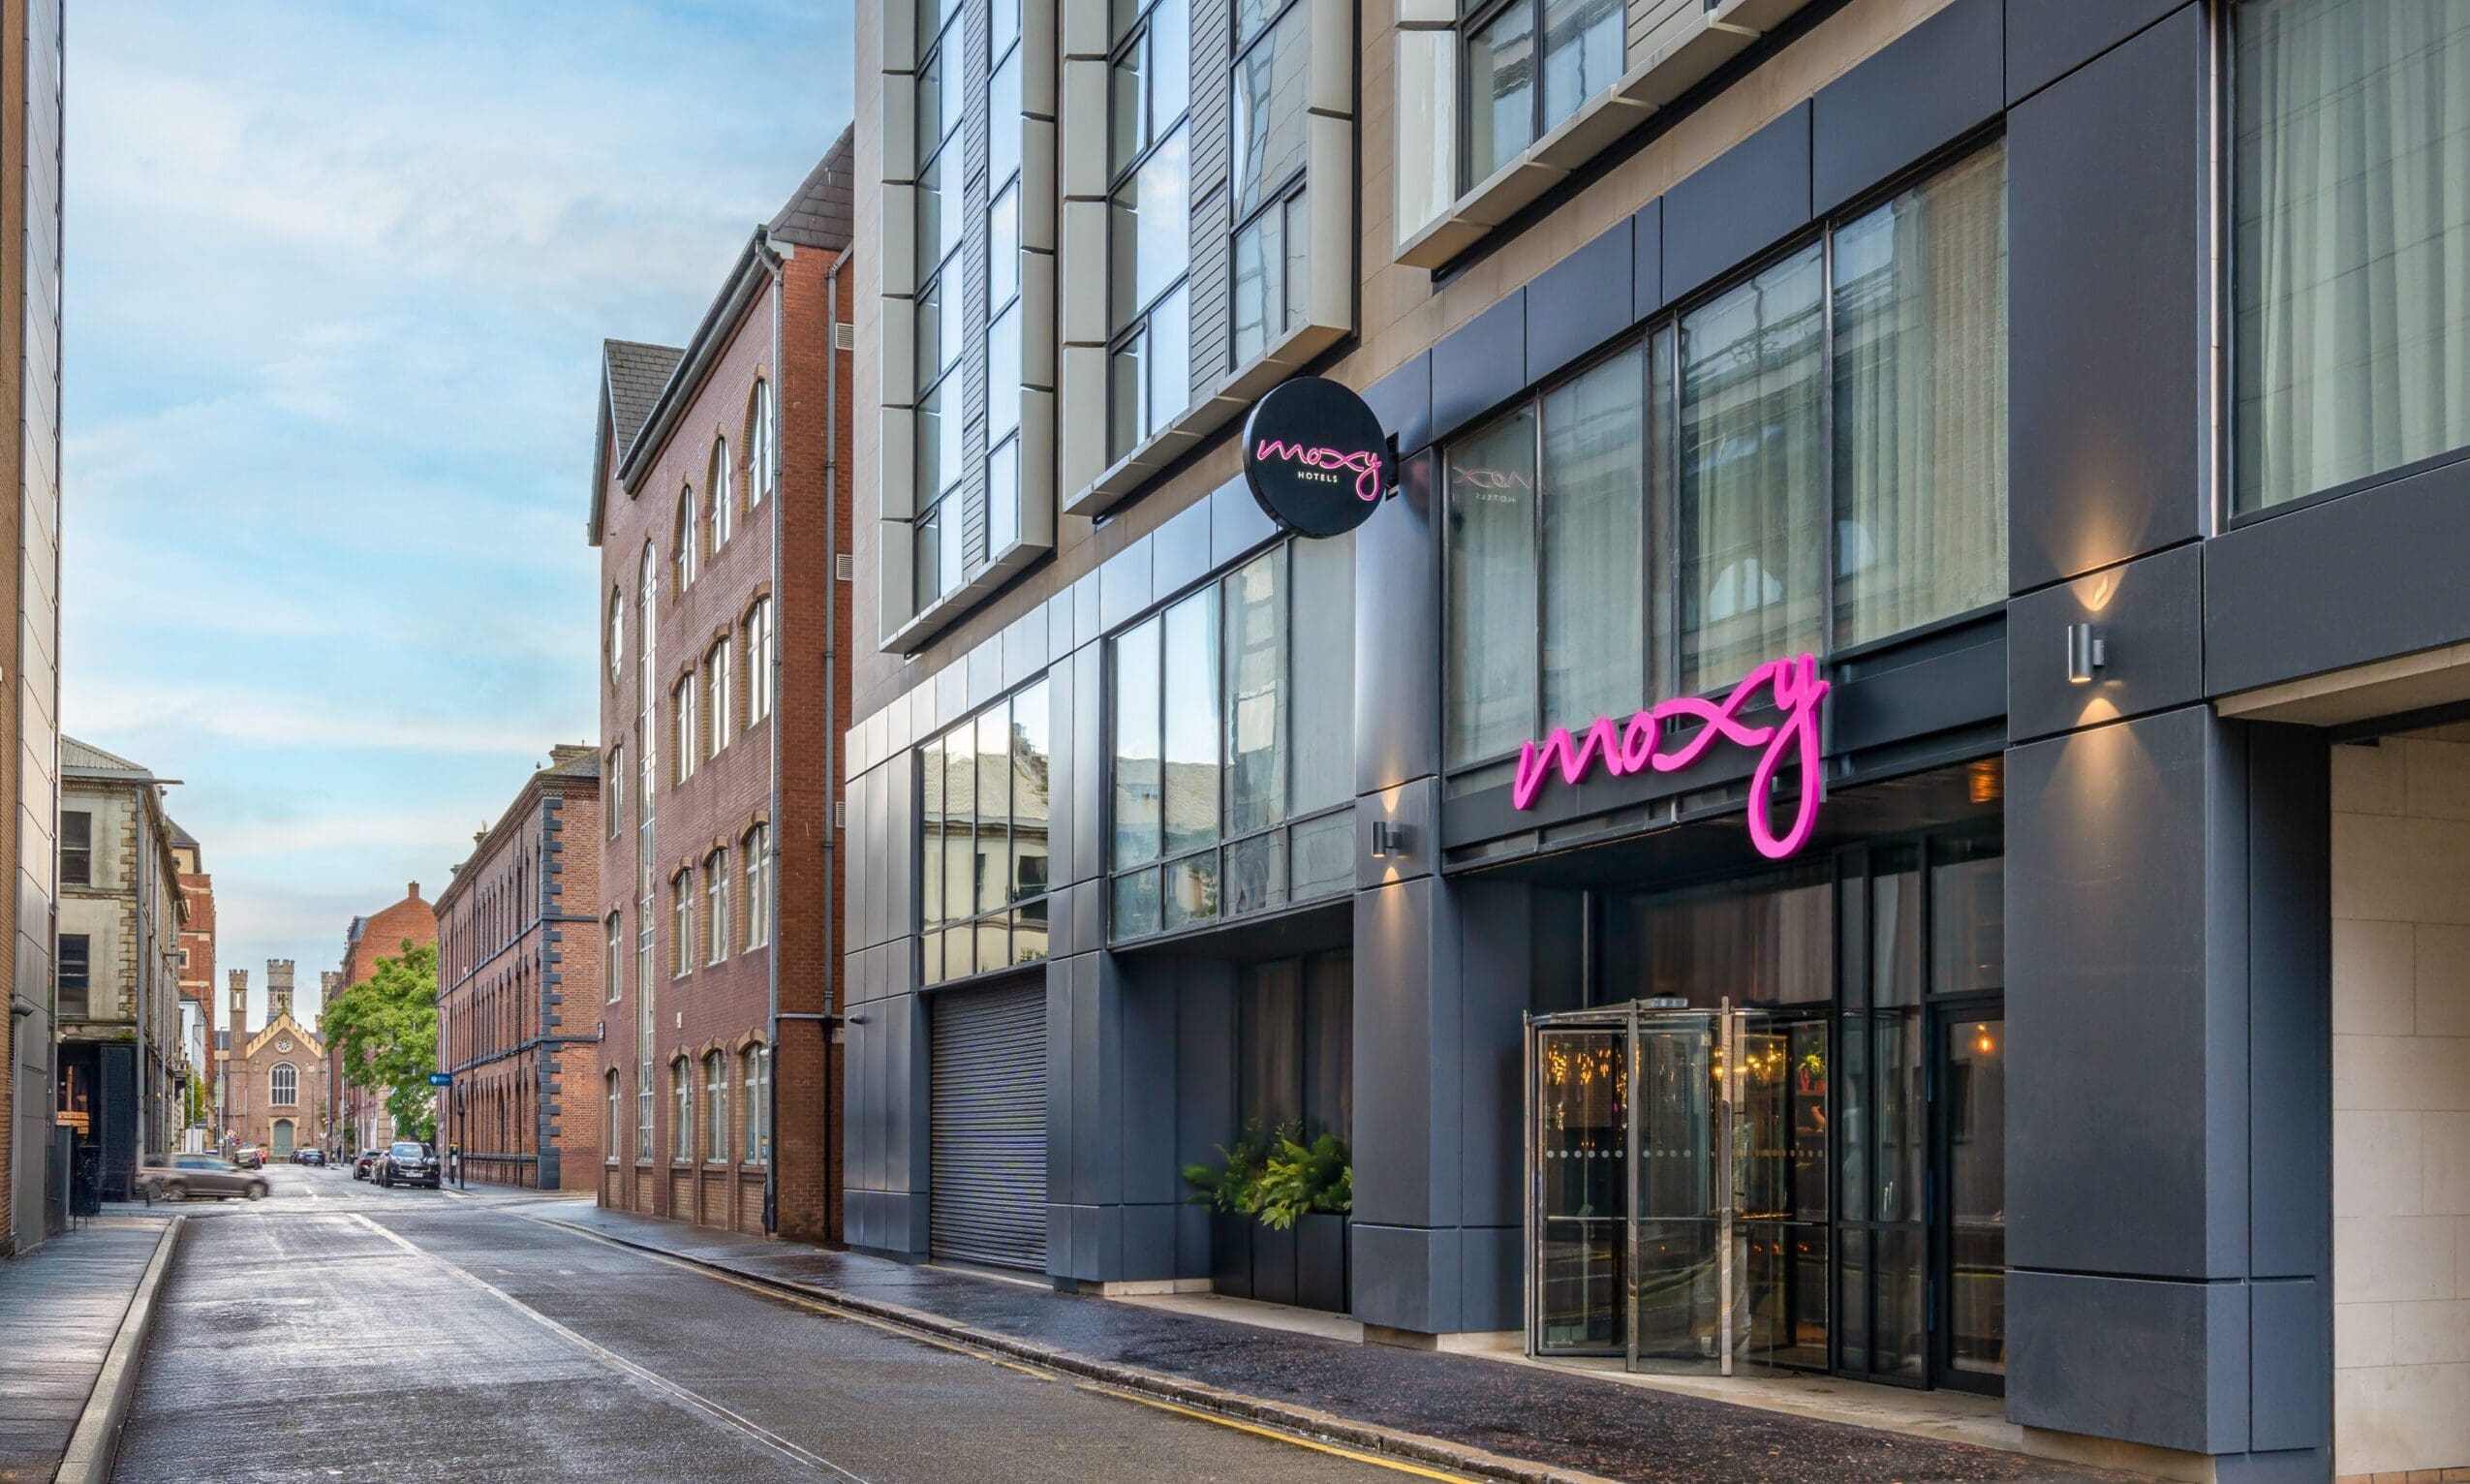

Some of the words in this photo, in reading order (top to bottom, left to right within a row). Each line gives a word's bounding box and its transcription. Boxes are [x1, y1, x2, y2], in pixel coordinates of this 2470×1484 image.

[1257, 440, 1382, 501] moxy
[1297, 471, 1339, 483] HOTELS
[1513, 652, 1832, 859] moxy
